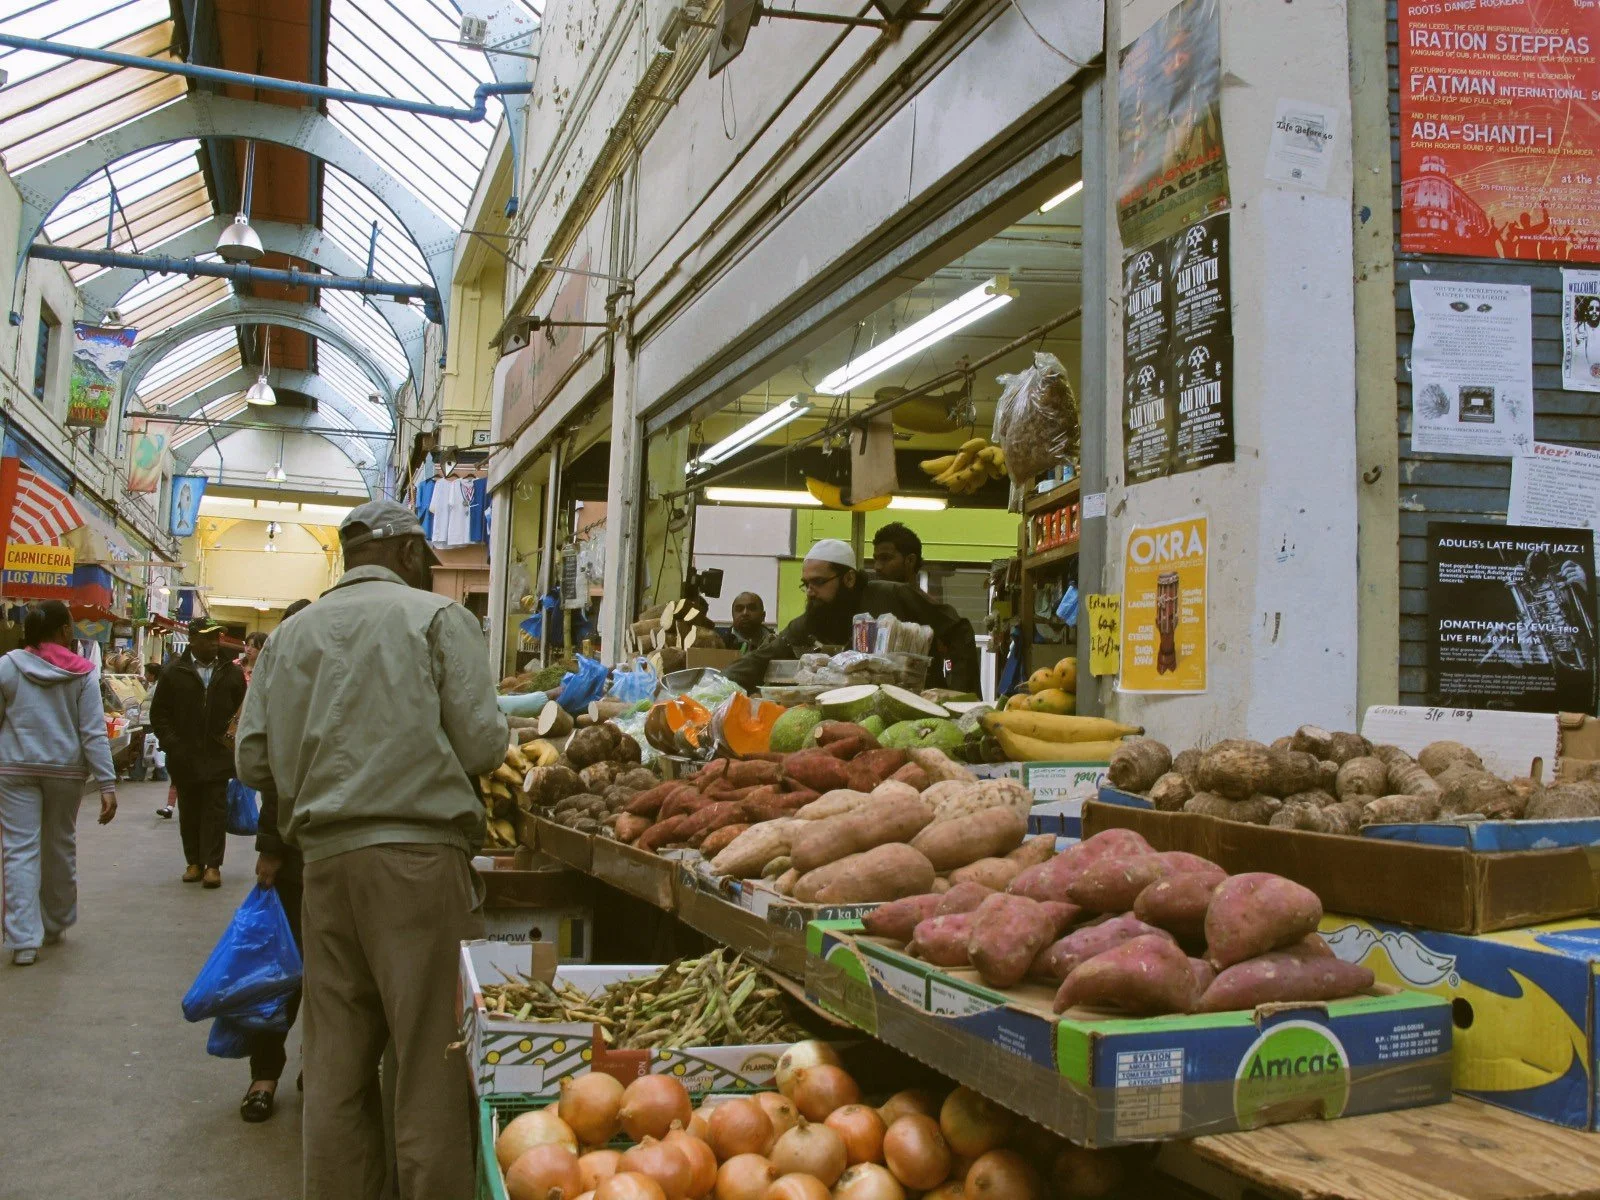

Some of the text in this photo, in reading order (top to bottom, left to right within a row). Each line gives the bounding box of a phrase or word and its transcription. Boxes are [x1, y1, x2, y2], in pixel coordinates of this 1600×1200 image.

[1409, 3, 1441, 16] ROOTS
[1444, 0, 1477, 12] DANCE
[1409, 30, 1590, 54] IRATION STEPPAS
[1410, 74, 1496, 96] FATMAN
[1500, 86, 1587, 100] INTERNATIONAL
[1276, 121, 1293, 131] Life
[1294, 125, 1321, 137] Before
[1411, 121, 1553, 146] ABA-SHANTI-I
[1434, 142, 1461, 150] ROCKER
[1576, 173, 1592, 185] the
[1548, 216, 1574, 226] Tickets
[1193, 380, 1222, 409] YOUTH
[1187, 407, 1211, 419] SOUND
[1130, 525, 1203, 565] OKRA
[1438, 539, 1485, 549] ADULIS's
[1487, 541, 1513, 550] LATE
[1515, 542, 1551, 552] NIGHT
[1552, 544, 1579, 554] JAZZ
[8, 551, 72, 568] CARNICERIA
[7, 571, 68, 586] LOS ANDES
[1439, 620, 1506, 630] JONATHAN
[1558, 626, 1579, 634] TRIO
[1440, 634, 1463, 642] LIVE
[1465, 635, 1481, 643] FRI
[838, 909, 851, 920] kg
[1133, 1052, 1170, 1062] STATION
[1249, 1053, 1339, 1080] Amcas
